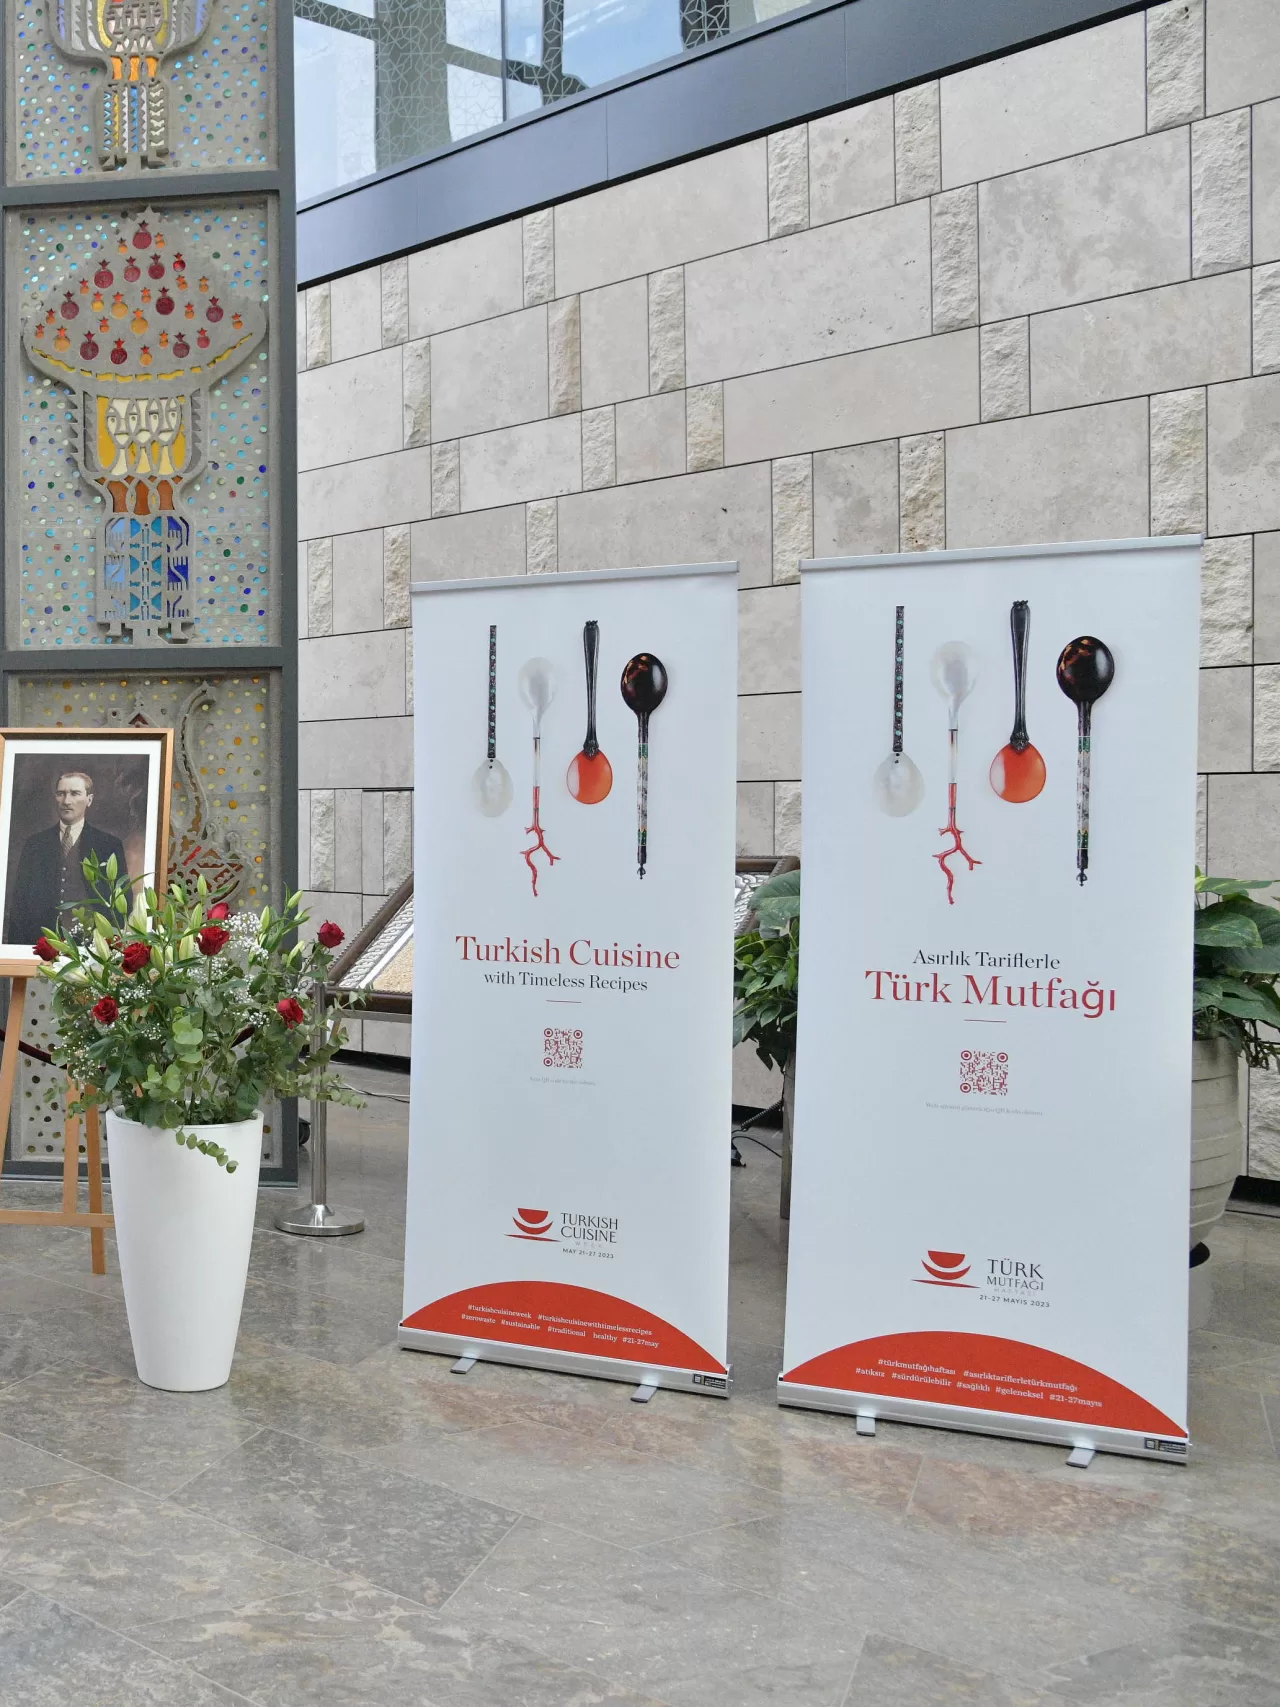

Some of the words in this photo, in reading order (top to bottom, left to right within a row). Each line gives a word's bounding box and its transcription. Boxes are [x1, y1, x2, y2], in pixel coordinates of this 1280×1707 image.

[455, 935, 561, 964] Turkish
[569, 939, 680, 969] Cuisine
[912, 949, 971, 966] Asırlık
[975, 952, 1061, 970] Tariflerle
[484, 970, 515, 986] with
[519, 971, 585, 988] Timeless
[589, 974, 648, 993] Recipes
[865, 970, 953, 1004] Türk
[962, 974, 1116, 1019] Mutfağı
[560, 1212, 618, 1230] TURKISH
[560, 1225, 617, 1243] CUISINE
[987, 1258, 1044, 1280] TÜRK
[979, 1294, 1001, 1302] 21-27
[1030, 1300, 1051, 1308] 2023
[461, 1313, 496, 1324] #zerowaste
[500, 1319, 541, 1331] #sustainable
[547, 1326, 586, 1337] #traditional
[593, 1332, 618, 1343] healthy
[467, 1304, 532, 1319] #turkishcuisineweek
[537, 1314, 653, 1336] #turkishcuisinewithtimelessrecipes
[995, 1386, 1044, 1400] #geleneksel
